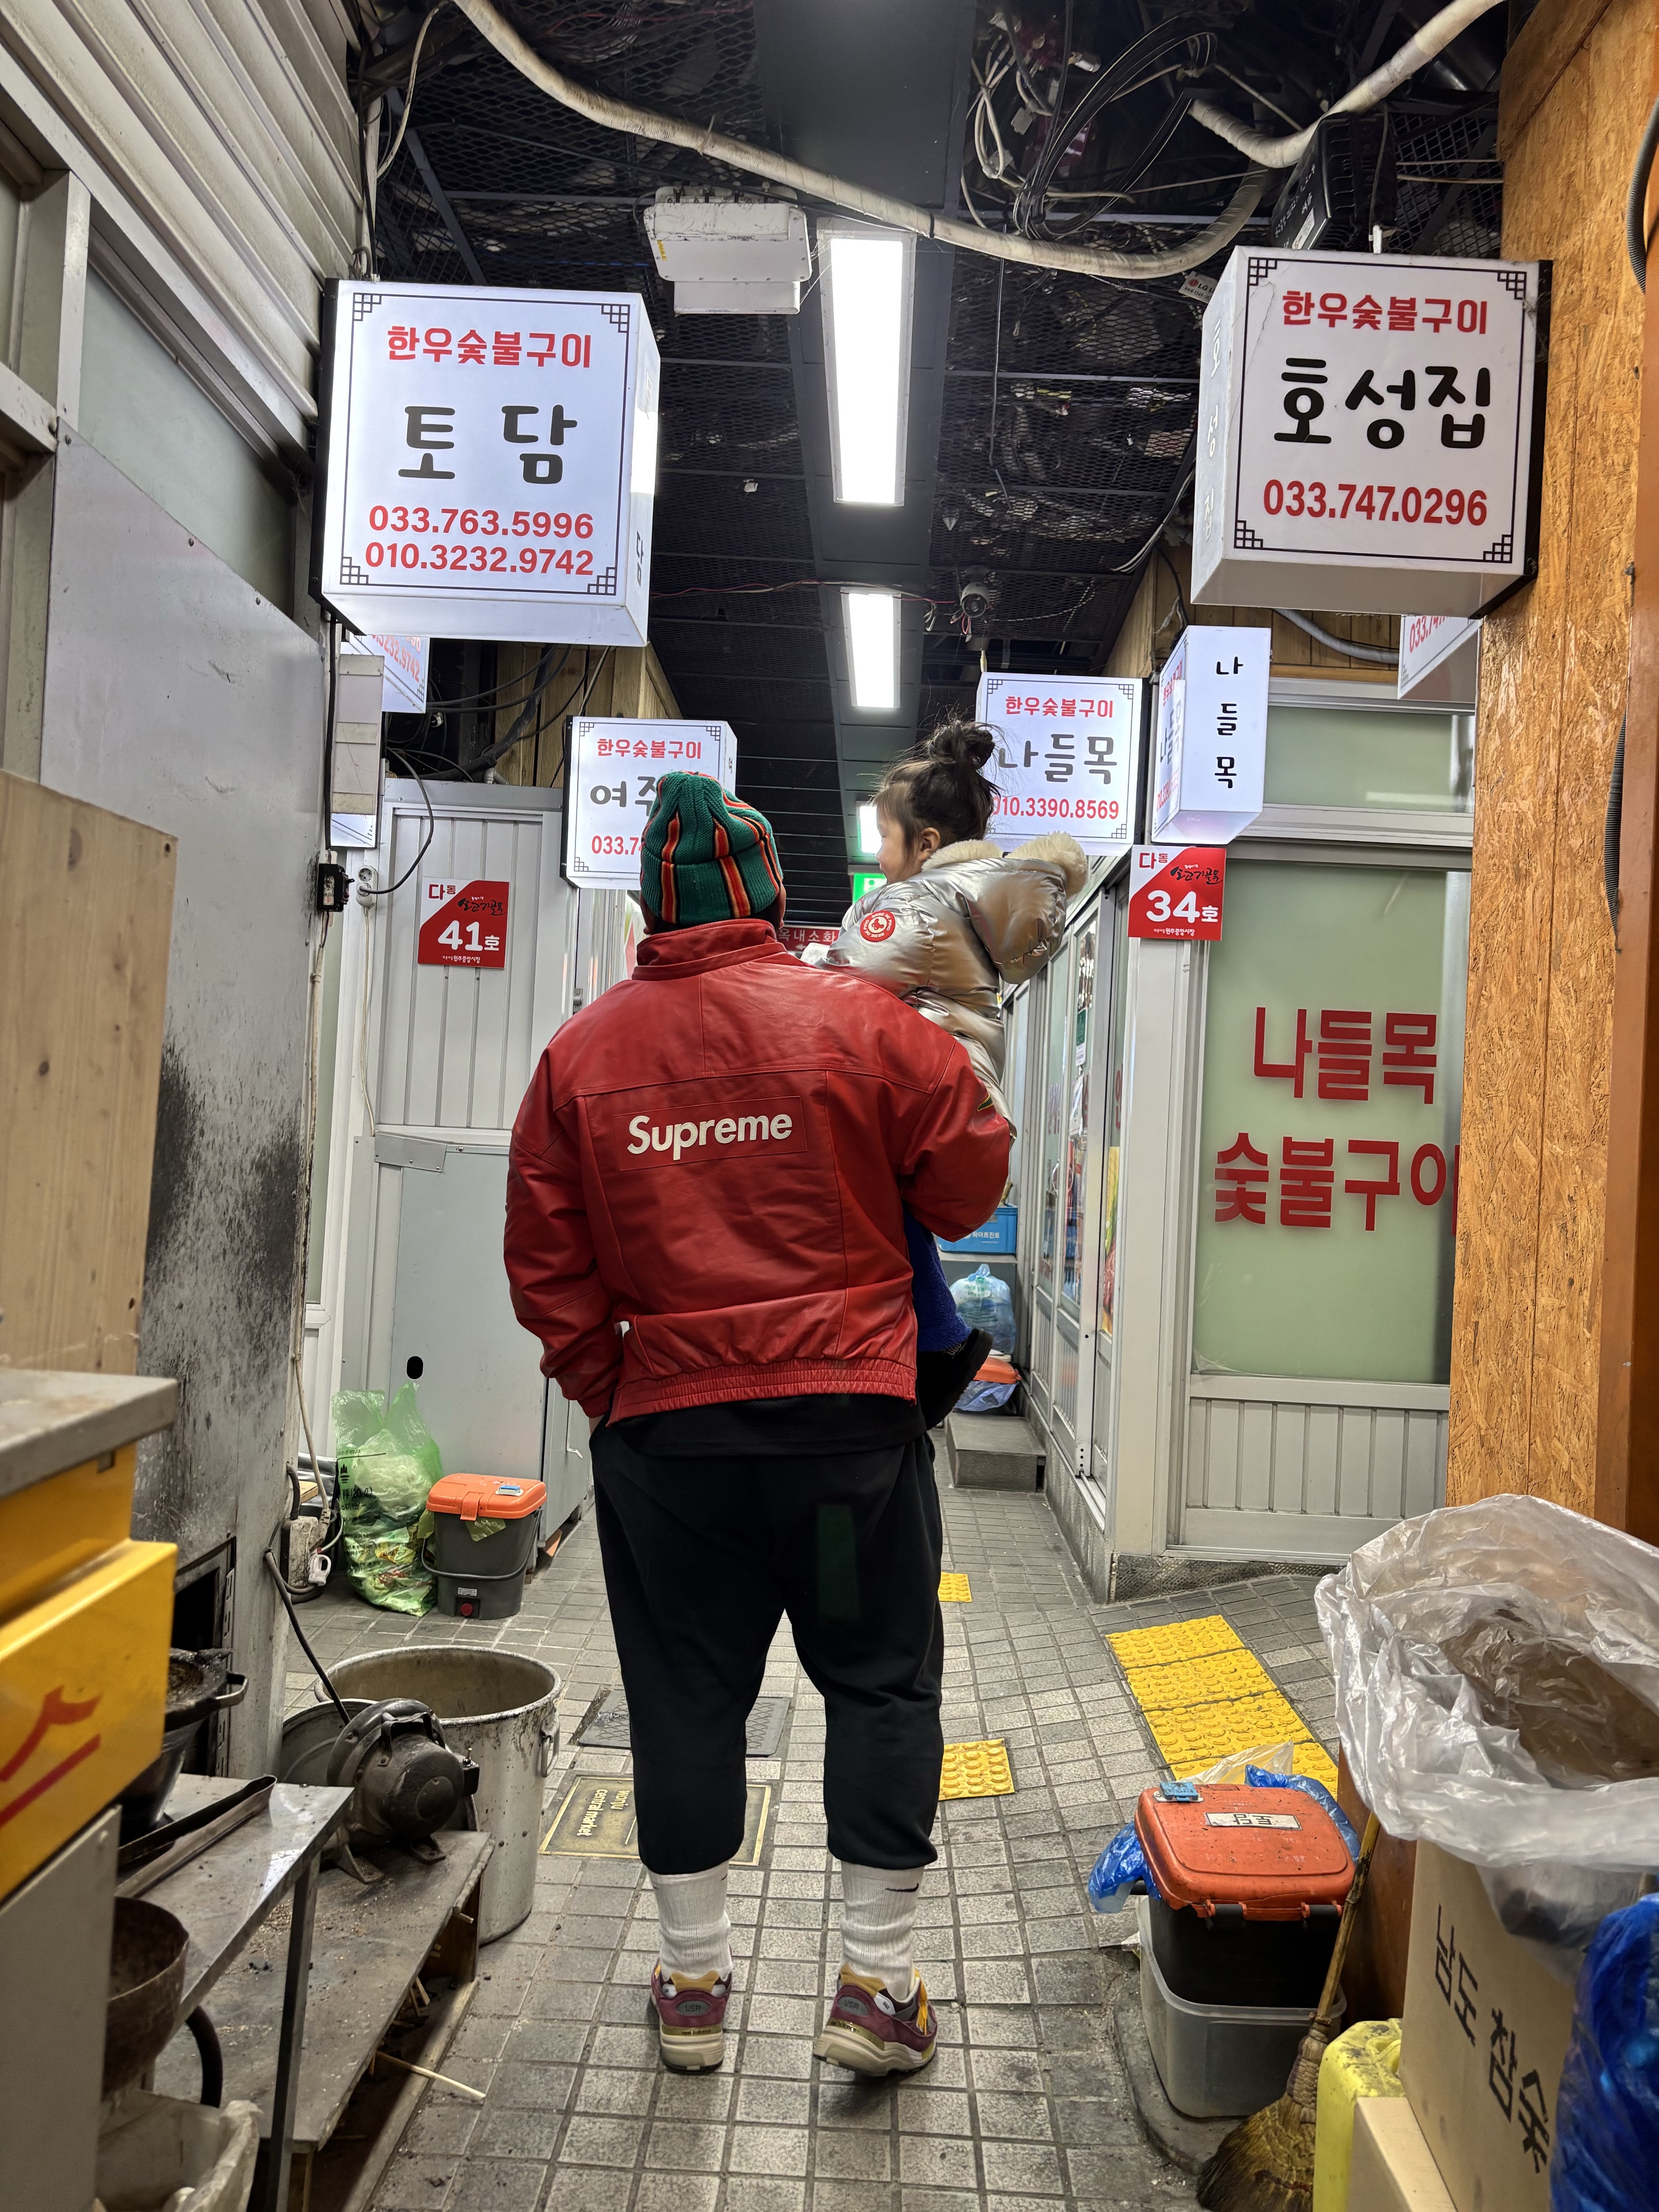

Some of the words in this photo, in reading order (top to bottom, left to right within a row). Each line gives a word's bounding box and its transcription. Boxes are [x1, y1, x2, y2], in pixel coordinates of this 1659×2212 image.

[1283, 290, 1487, 334] 한우숯불구이
[388, 326, 591, 368] 한우숯불구이
[1274, 357, 1491, 449] 호성집
[1264, 479, 1487, 526] 033.747.0296
[369, 505, 593, 539] 033.763.5996
[365, 542, 593, 575] 010.3232.9742
[1005, 696, 1114, 718] 한우숯불구이
[1214, 656, 1243, 788] 나들목
[597, 739, 701, 759] 한우숯불구이
[998, 734, 1117, 785] 나들목
[590, 776, 658, 816] 여주
[1146, 890, 1218, 923] 34호
[438, 920, 500, 951] 41호
[778, 928, 836, 942] 옥내소화
[1254, 1007, 1437, 1104] 나들목
[627, 1114, 792, 1161] Supreme
[1214, 1132, 1460, 1237] 숯불구이
[588, 1789, 608, 1811] central
[610, 1790, 630, 1810] wonju
[577, 1811, 598, 1836] market
[844, 2000, 859, 2010] USA
